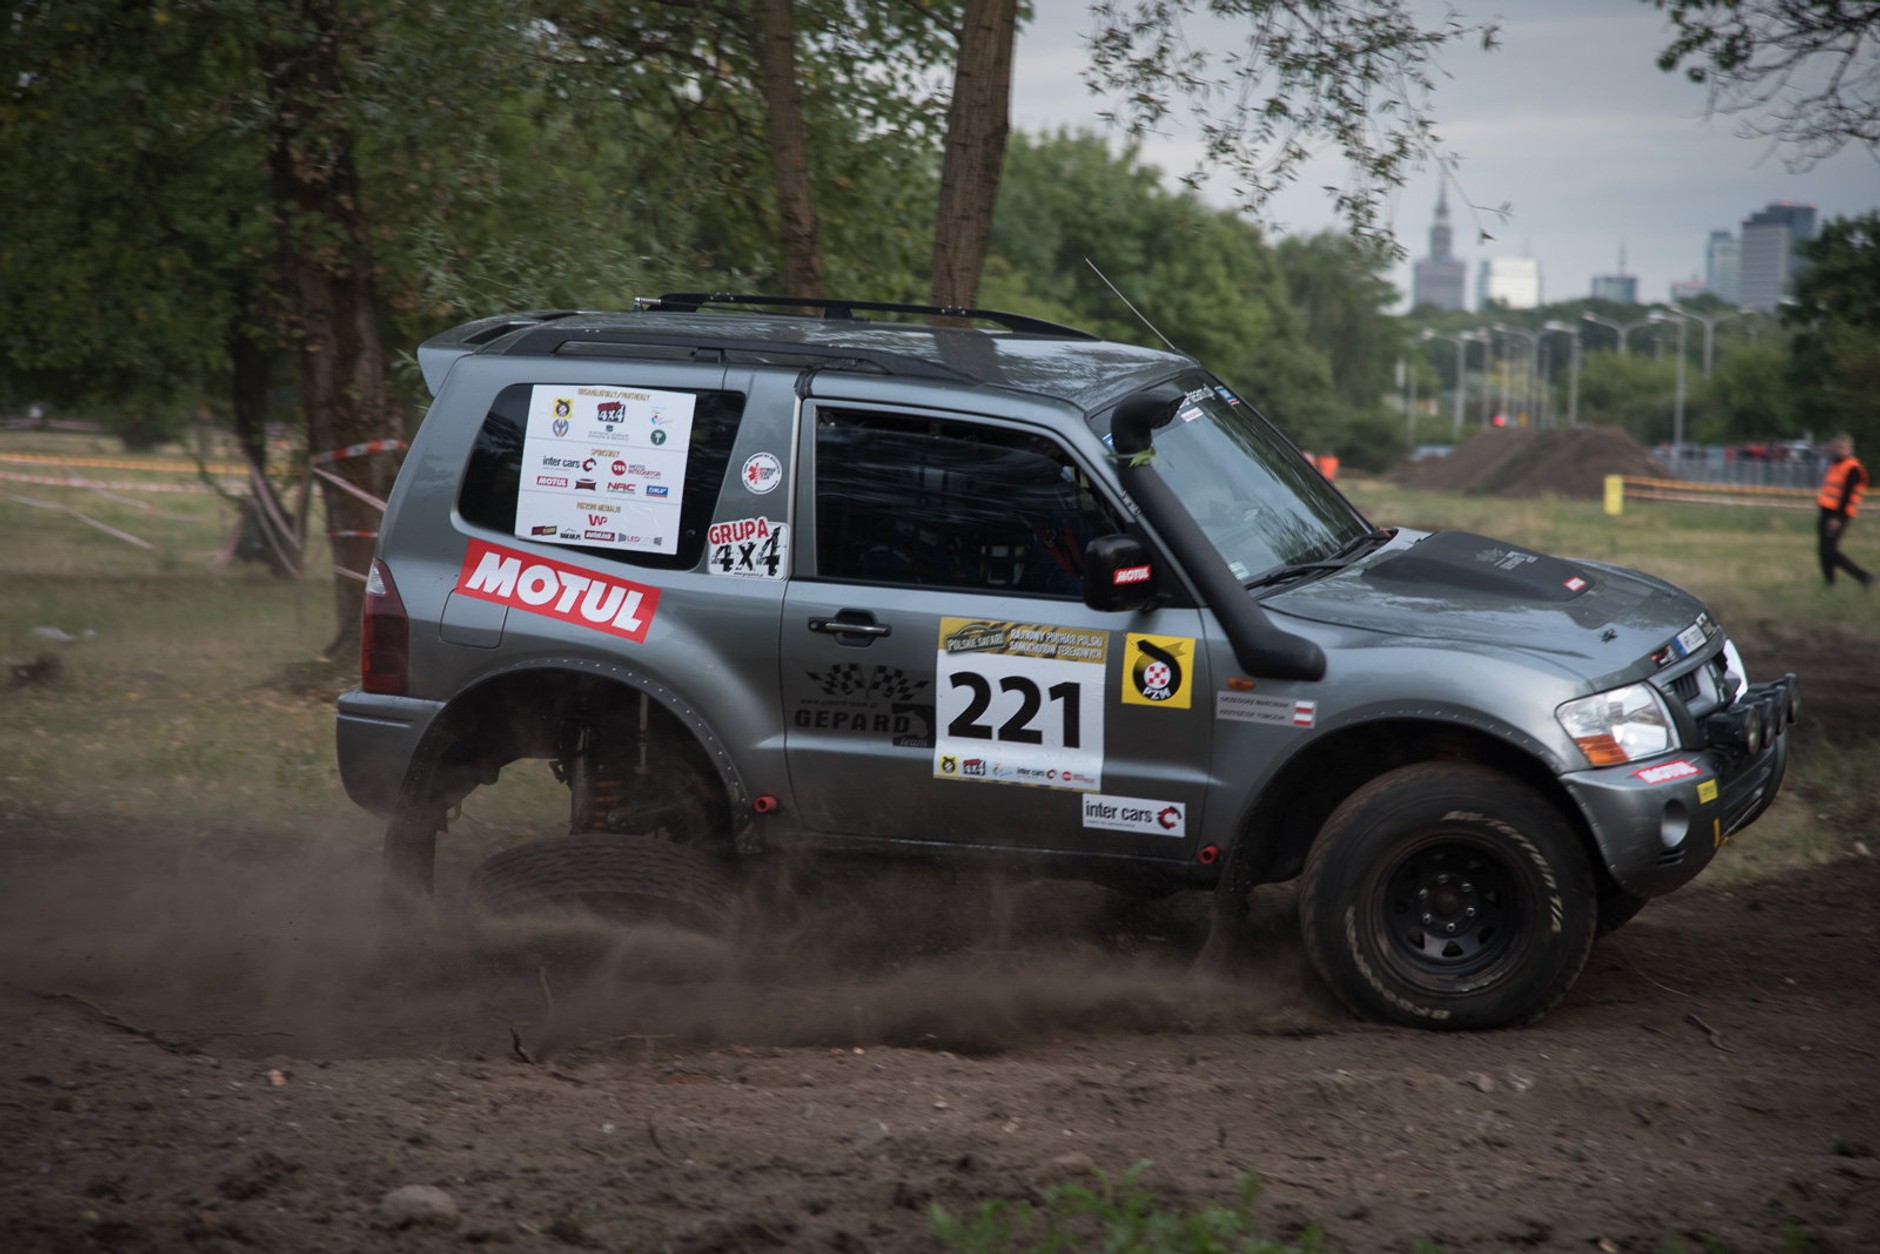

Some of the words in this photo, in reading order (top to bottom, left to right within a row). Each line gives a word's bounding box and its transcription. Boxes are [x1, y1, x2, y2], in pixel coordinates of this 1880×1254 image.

[543, 456, 561, 466] inter
[562, 459, 580, 469] cars
[538, 477, 567, 487] MOTUL
[588, 514, 607, 526] WP
[709, 518, 769, 545] GRUPA
[1115, 567, 1149, 583] MOTUL
[465, 551, 644, 632] MOTUL
[1143, 687, 1171, 700] PZM
[948, 671, 1081, 749] 221
[794, 709, 910, 733] GEPARD
[1085, 801, 1118, 819] inter
[1121, 808, 1153, 823] cars
